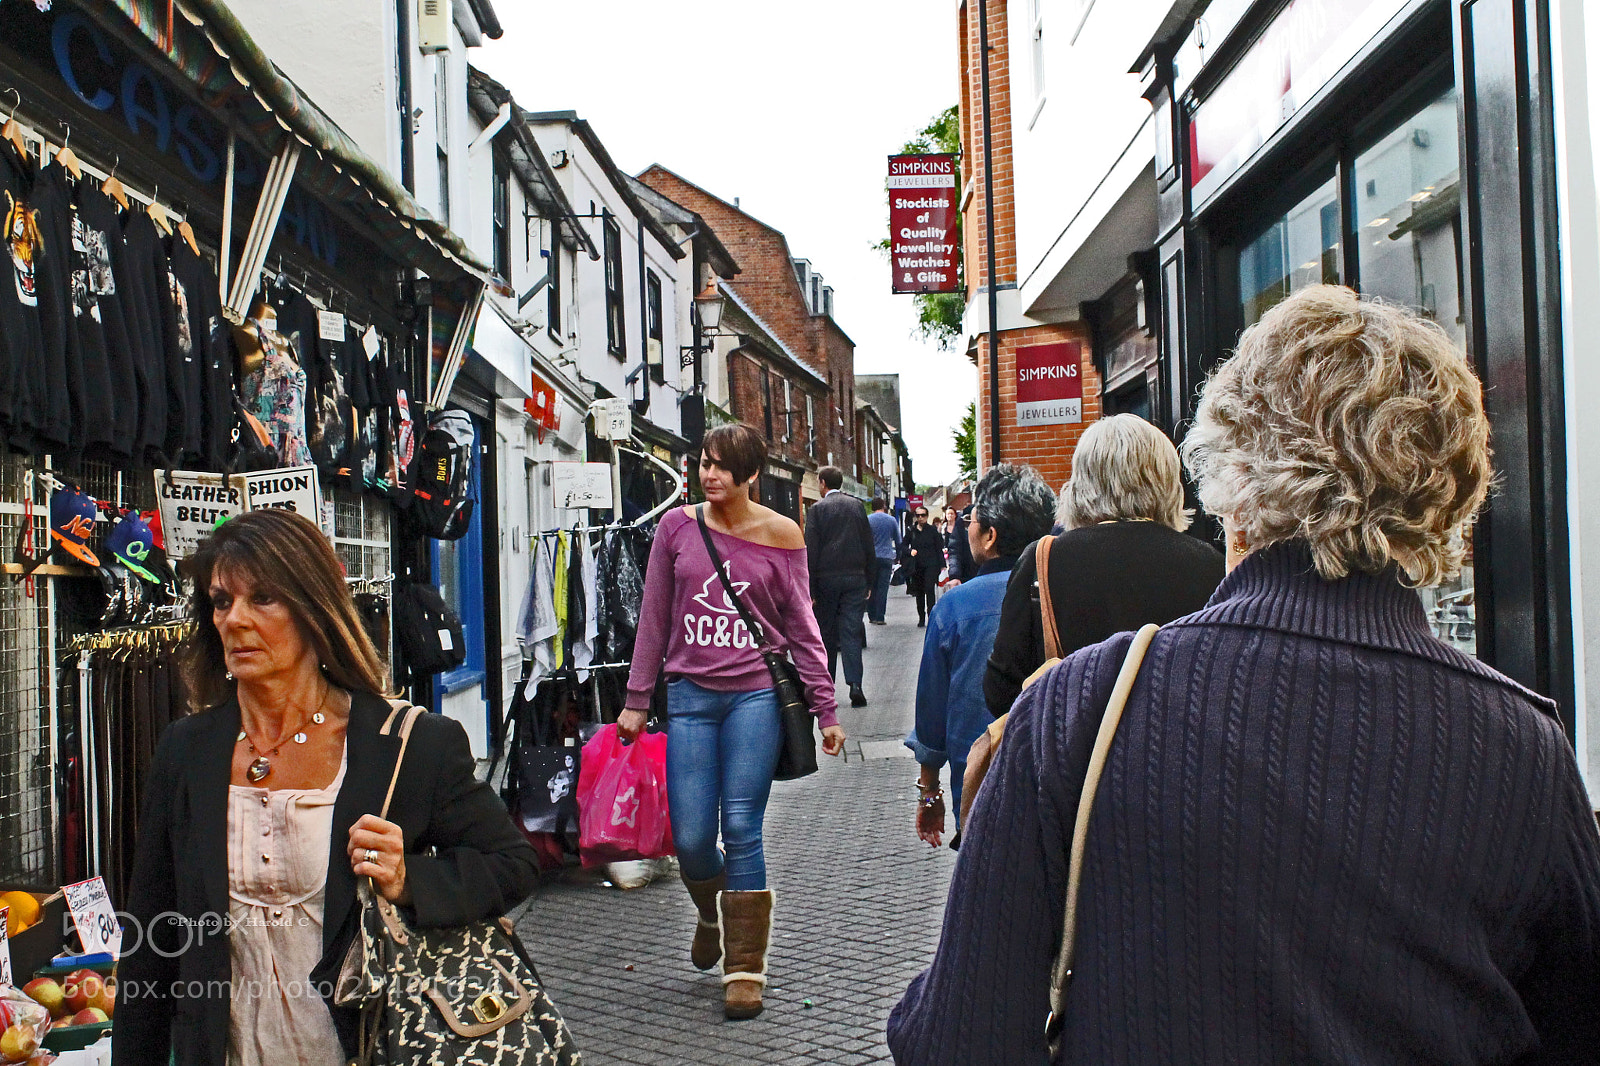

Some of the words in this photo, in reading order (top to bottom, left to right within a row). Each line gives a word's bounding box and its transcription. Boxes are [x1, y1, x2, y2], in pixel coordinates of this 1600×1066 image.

[891, 161, 951, 174] SIMPKINS
[893, 177, 950, 187] JEWELLERS
[895, 198, 950, 210] Stockists
[916, 212, 930, 223] of
[900, 228, 947, 241] Quality
[894, 243, 954, 255] Jewellery
[898, 257, 951, 268] Watches
[903, 273, 914, 283] &
[917, 272, 947, 283] Gifts
[1019, 364, 1077, 382] SIMPKINS
[1021, 407, 1077, 420] JEWELLERS
[162, 483, 239, 505] LEATHER
[177, 506, 229, 524] BELTS
